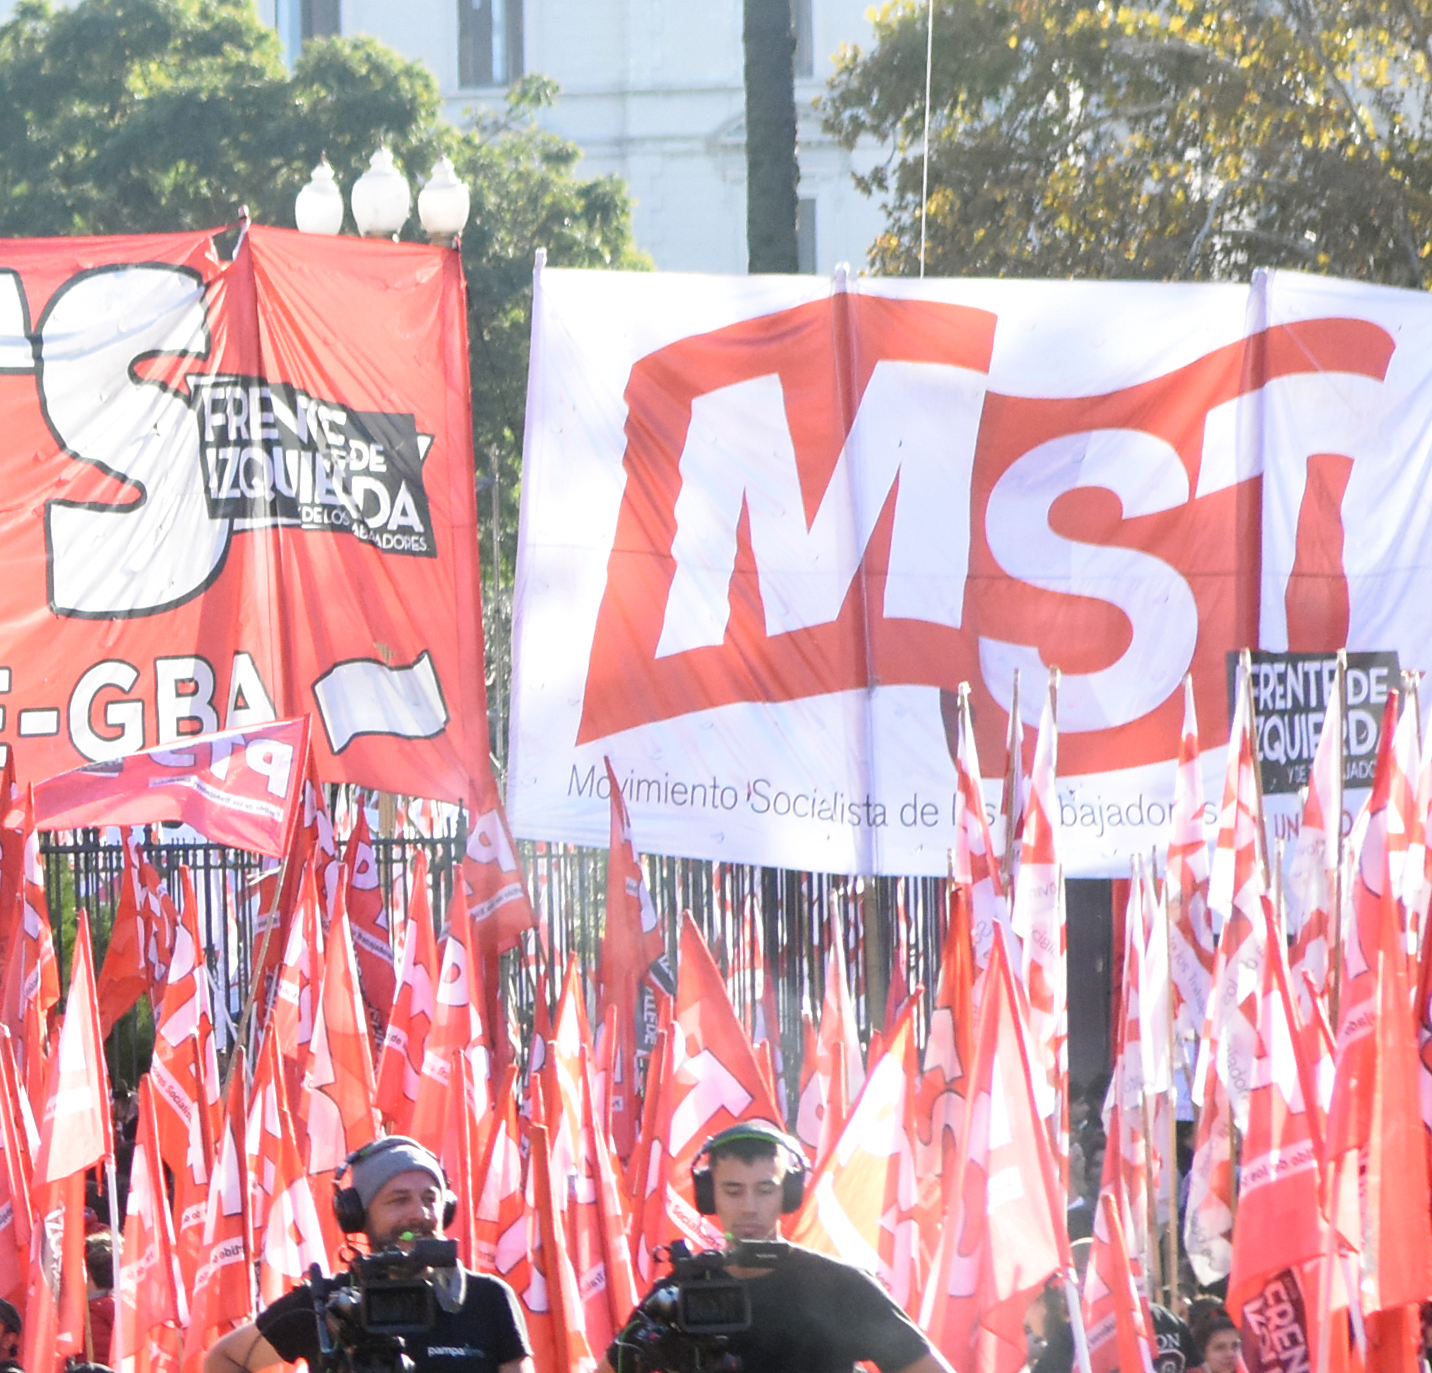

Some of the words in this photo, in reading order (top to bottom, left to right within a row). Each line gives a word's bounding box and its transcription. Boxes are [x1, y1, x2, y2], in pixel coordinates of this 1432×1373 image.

[348, 439, 387, 472] DE
[655, 359, 1386, 733] MST
[1347, 667, 1389, 705] DE
[1255, 710, 1380, 766] ZQUIED
[567, 763, 738, 811] Movimiento
[749, 778, 889, 828] Socialista
[900, 793, 939, 828] de
[953, 793, 997, 828] ls
[1058, 793, 1218, 837] bajadors
